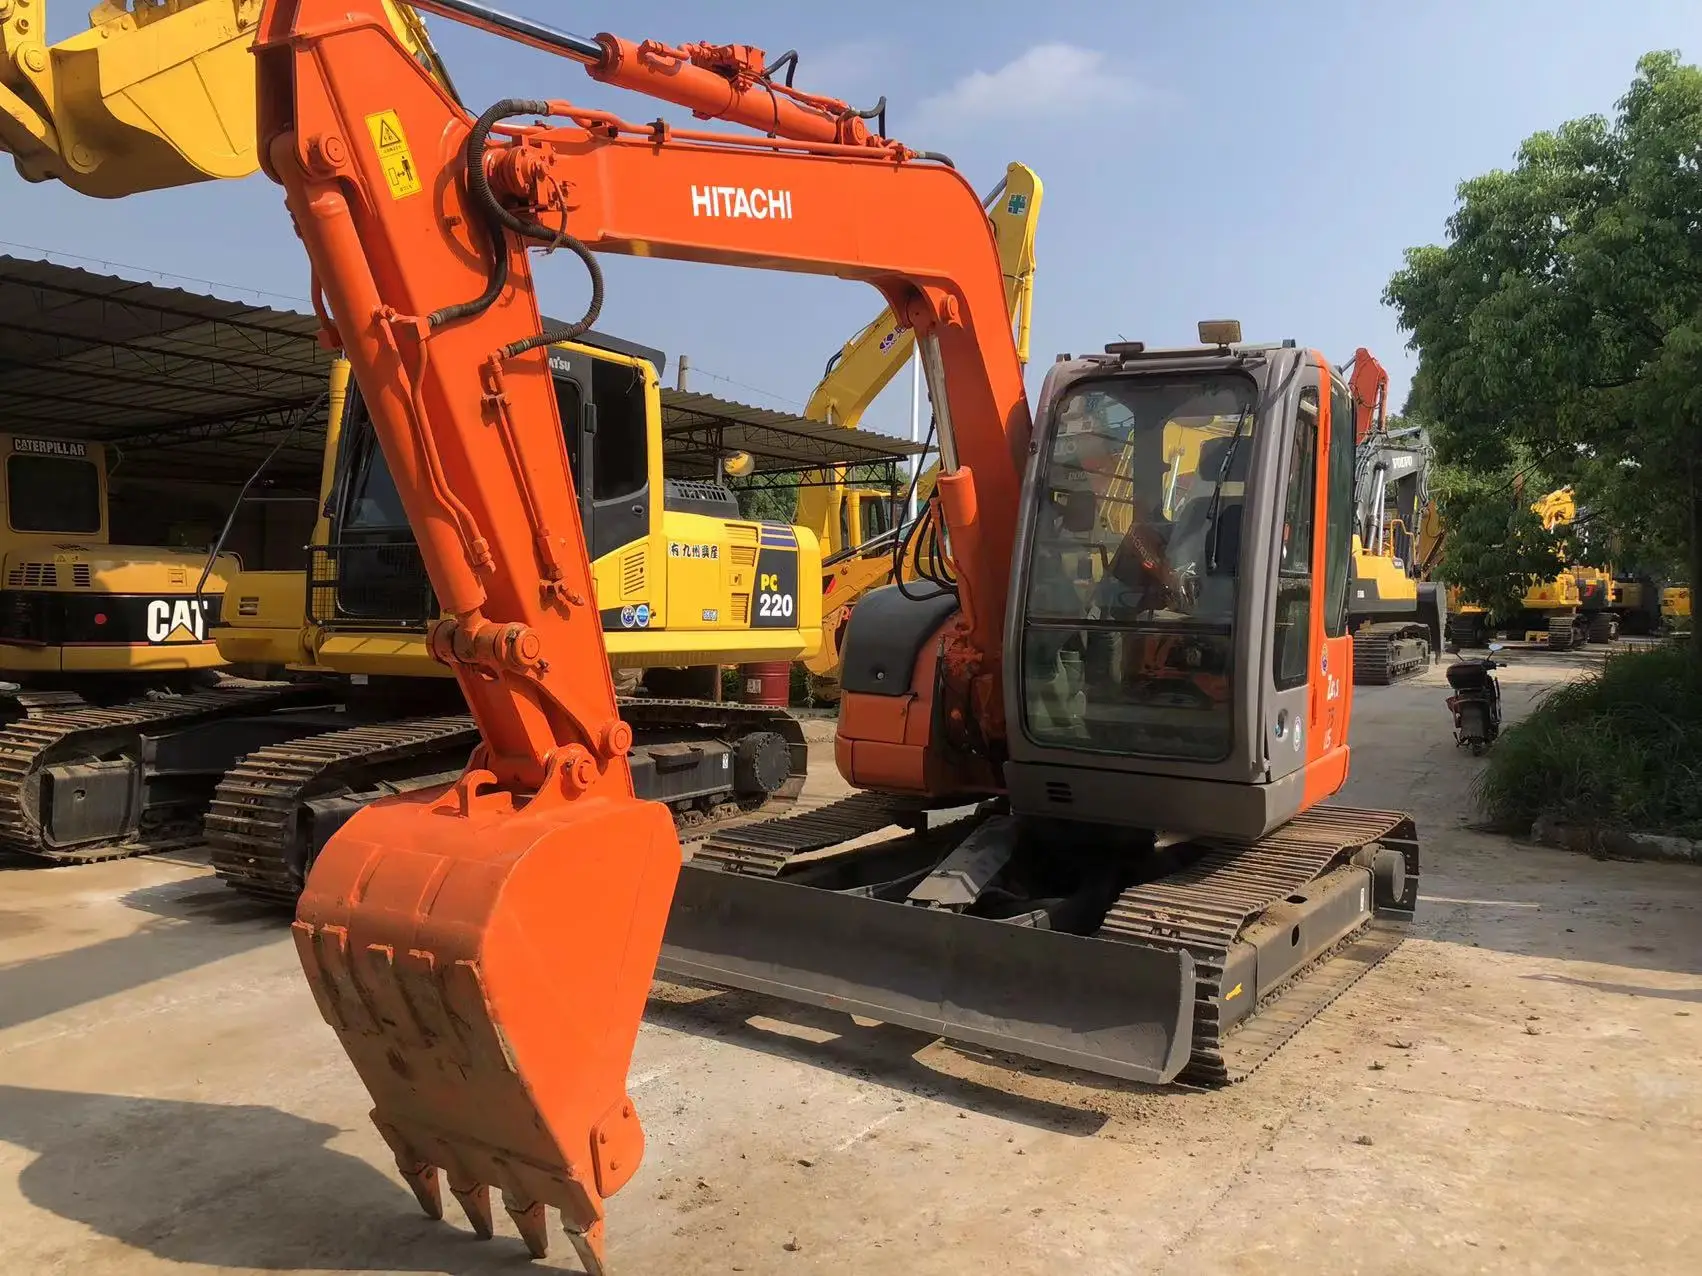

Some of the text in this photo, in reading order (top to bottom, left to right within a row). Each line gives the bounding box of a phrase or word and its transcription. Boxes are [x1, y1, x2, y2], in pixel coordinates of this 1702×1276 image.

[690, 184, 792, 219] HITACHI
[548, 356, 570, 371] ATSU
[14, 438, 85, 456] CATERPILLAR
[760, 573, 778, 592] PC
[759, 593, 793, 617] 220
[146, 600, 208, 642] CAT
